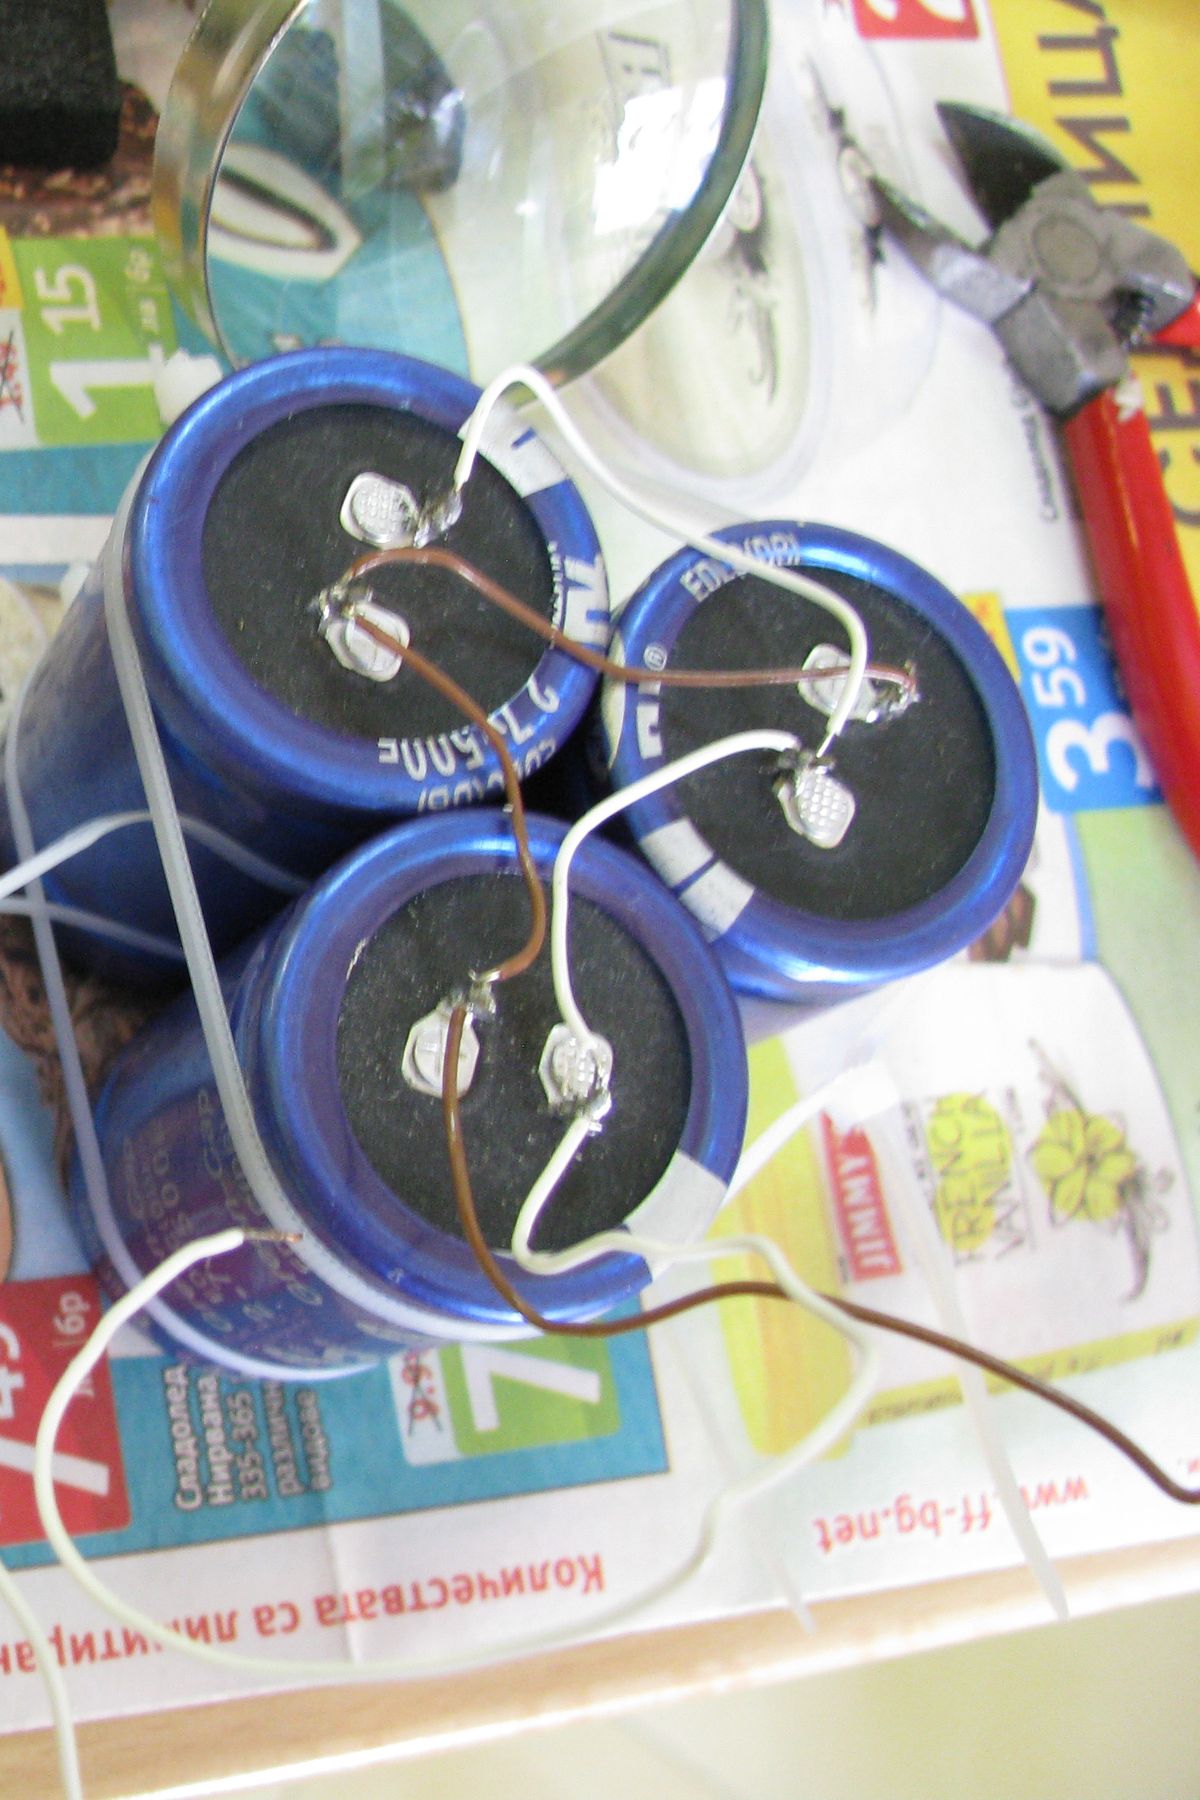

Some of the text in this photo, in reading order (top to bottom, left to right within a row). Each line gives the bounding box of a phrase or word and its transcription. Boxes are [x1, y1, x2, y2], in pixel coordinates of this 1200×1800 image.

[33, 263, 102, 335] 15
[1022, 627, 1087, 708] 59
[839, 1155, 894, 1268] JIMMY
[458, 1341, 600, 1432] 7
[198, 1375, 236, 1506] Нирвана
[253, 1600, 299, 1638] са
[315, 1553, 606, 1627] Количествата
